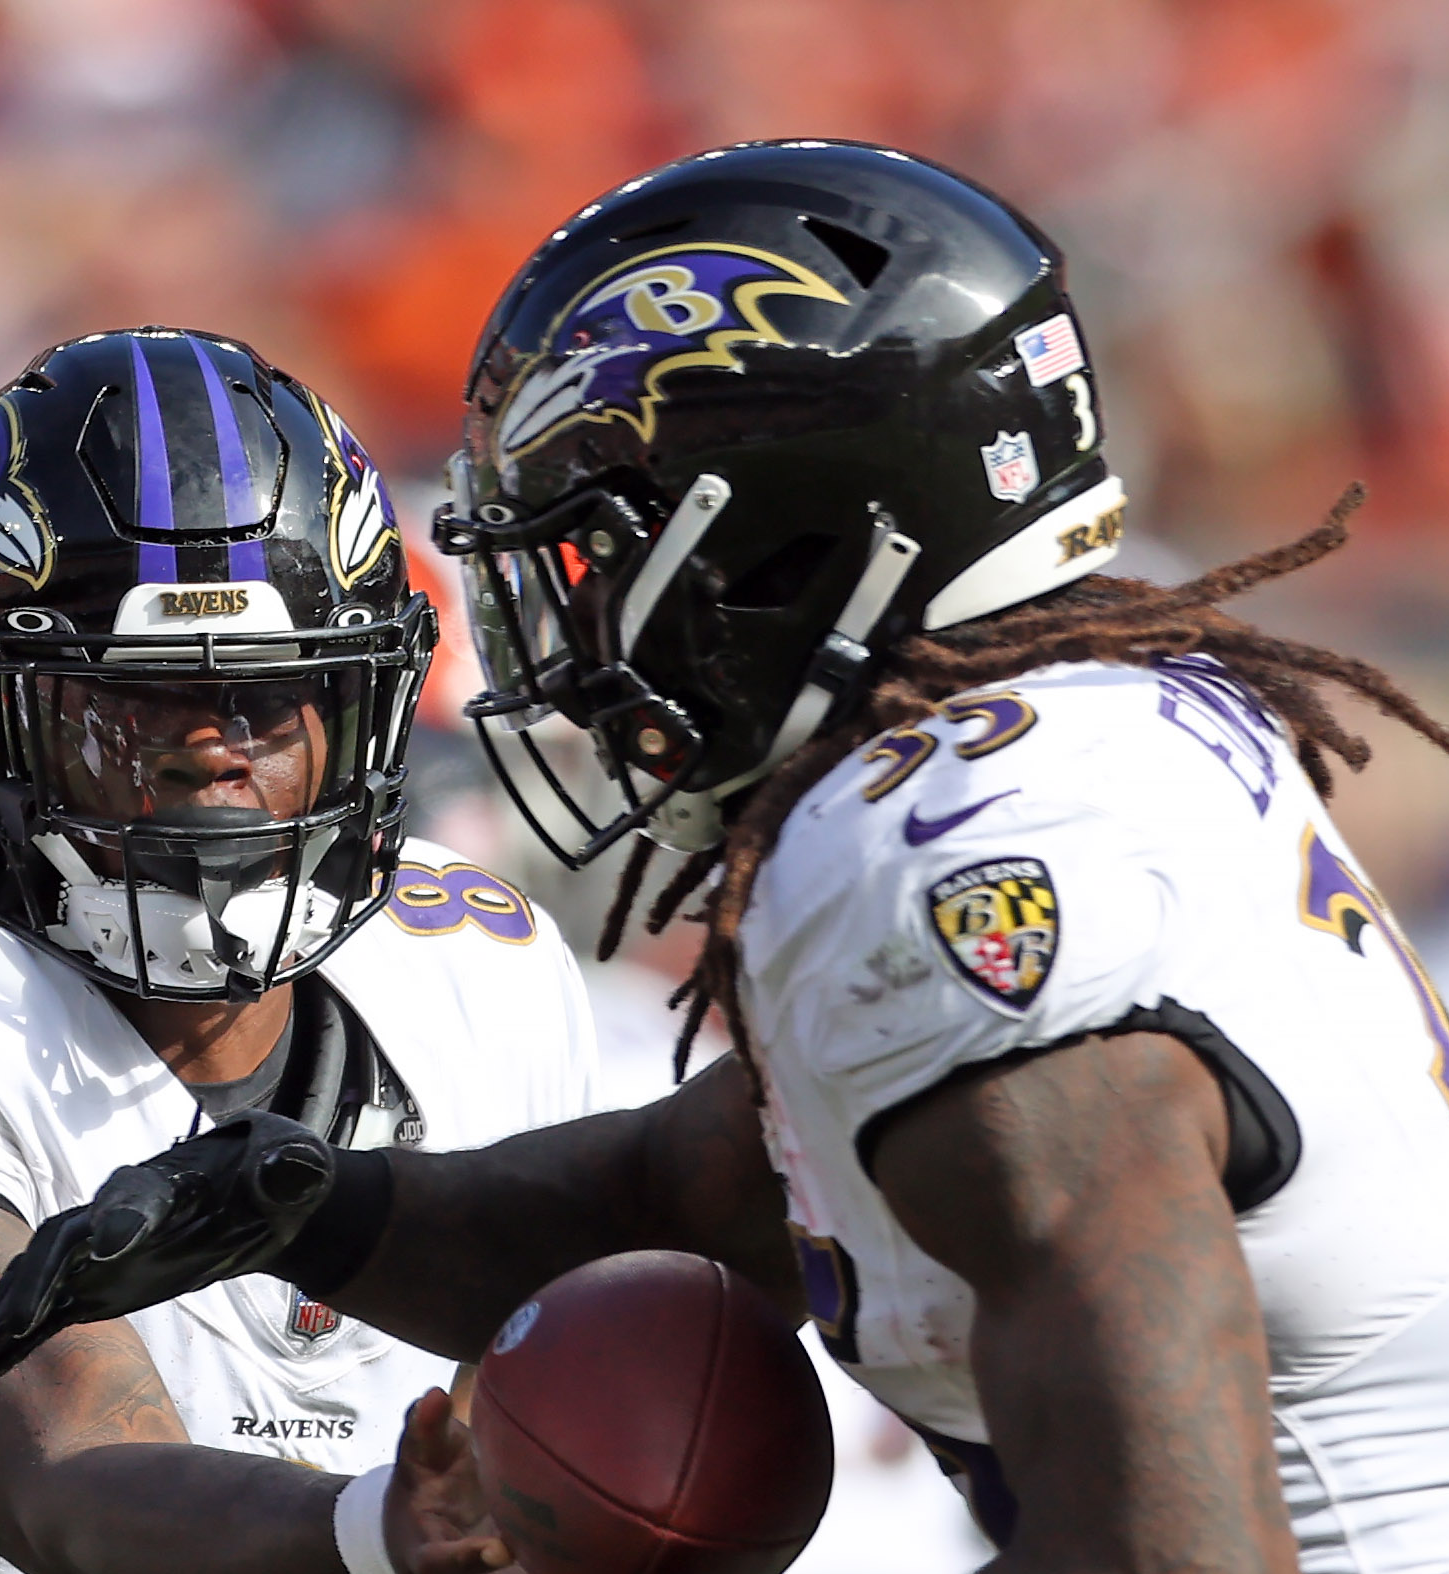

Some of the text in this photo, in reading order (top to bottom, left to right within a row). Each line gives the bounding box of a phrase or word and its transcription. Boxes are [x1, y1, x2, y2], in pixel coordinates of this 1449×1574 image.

[577, 265, 723, 336] B
[159, 589, 249, 617] RAVENS
[372, 860, 538, 946] 8
[296, 1303, 335, 1332] NFL
[233, 1416, 355, 1440] RAVENS
